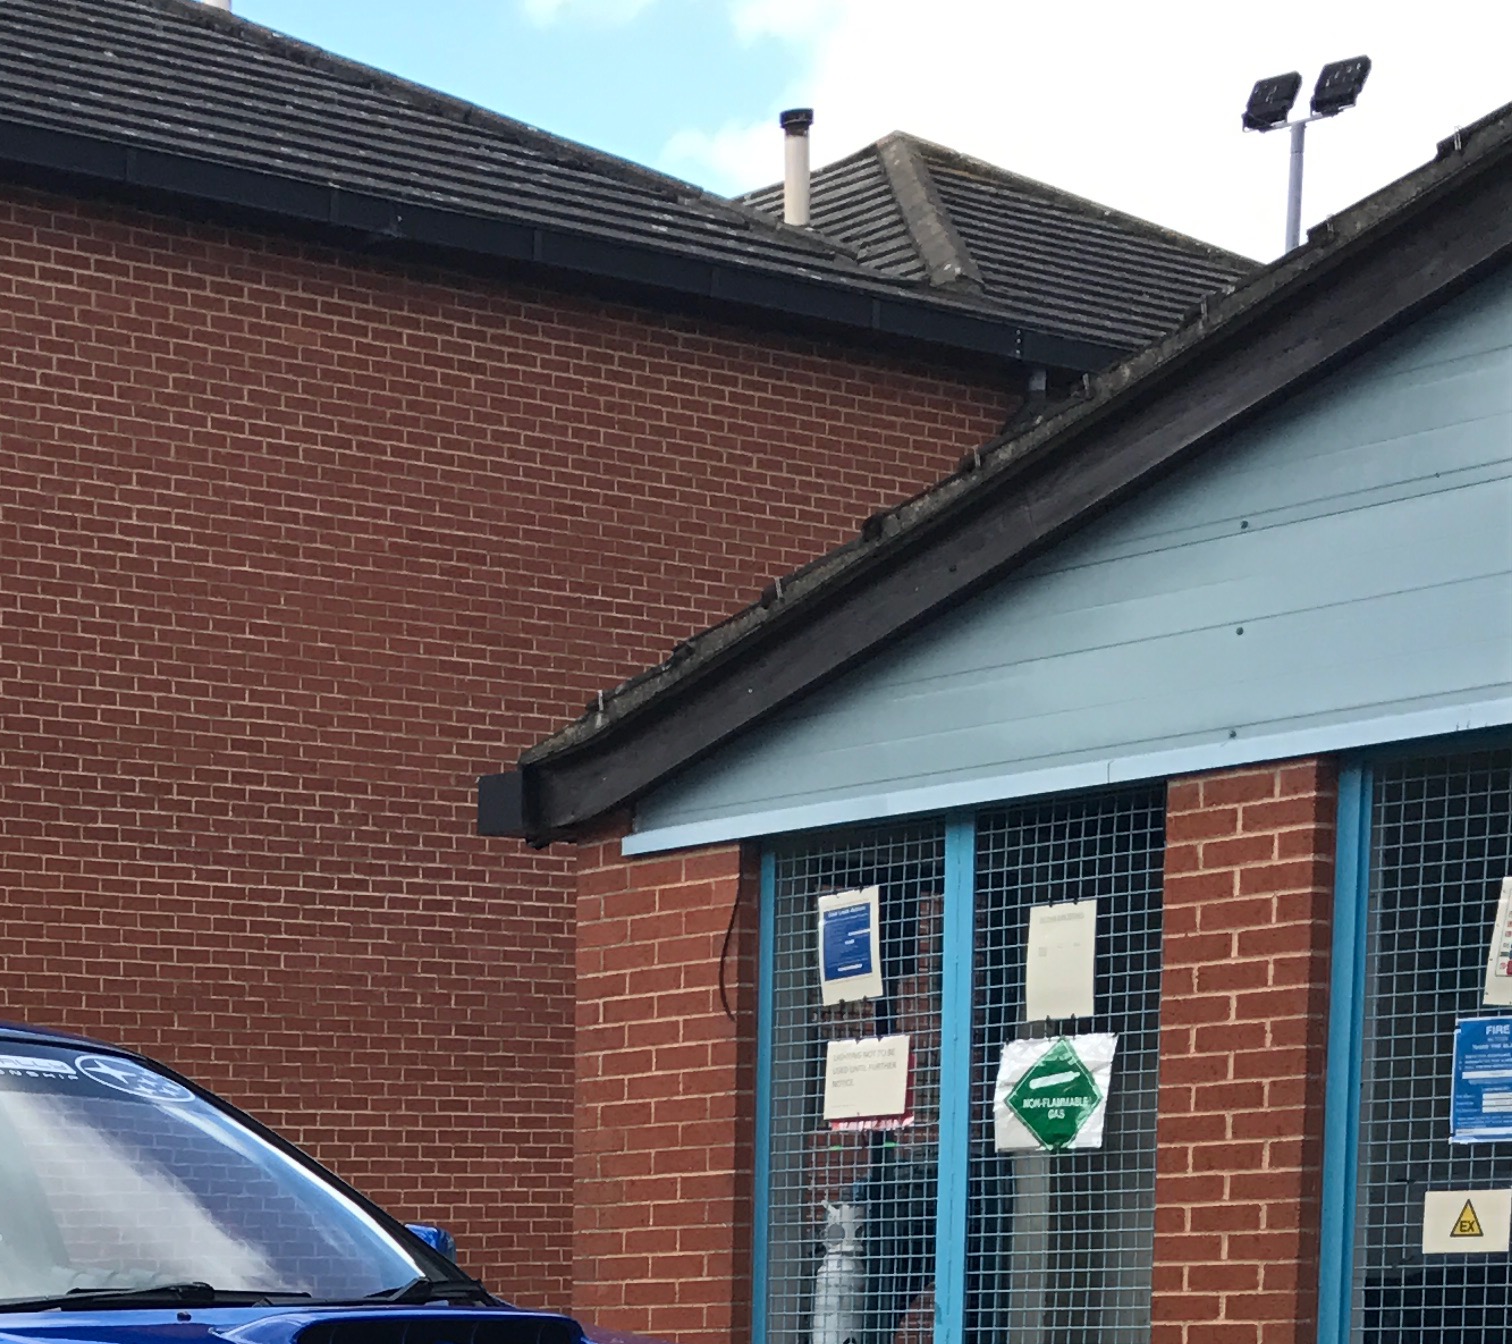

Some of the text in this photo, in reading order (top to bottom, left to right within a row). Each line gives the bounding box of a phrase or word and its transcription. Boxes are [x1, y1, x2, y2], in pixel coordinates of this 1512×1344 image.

[1486, 1024, 1510, 1035] FIRE
[1023, 1096, 1088, 1108] NON-FLAMMABLE
[1048, 1109, 1065, 1120] GAS
[1460, 1220, 1476, 1232] EX
